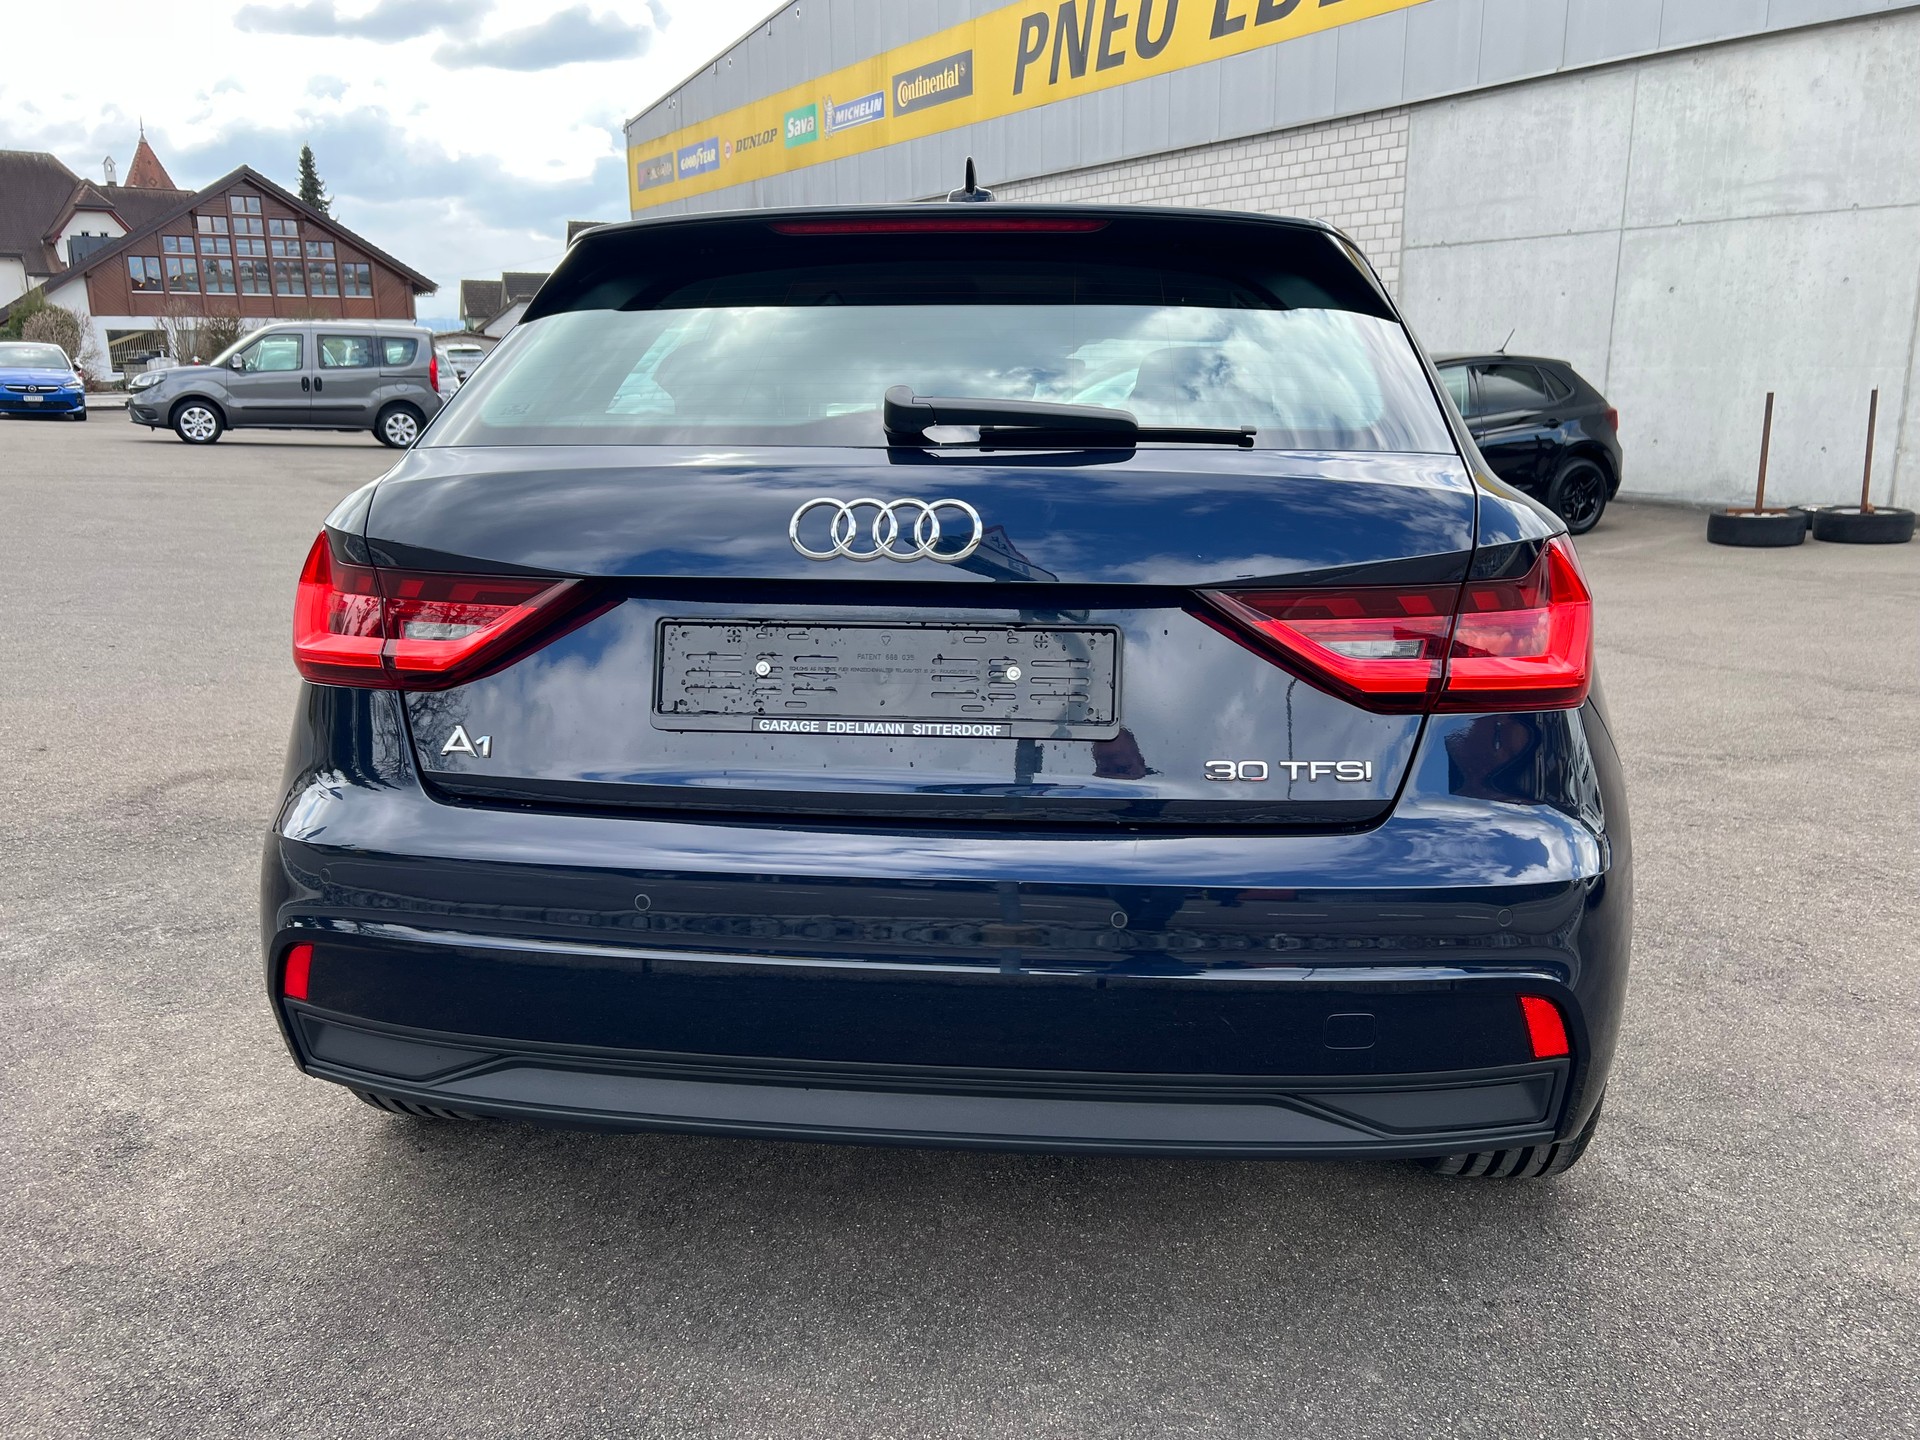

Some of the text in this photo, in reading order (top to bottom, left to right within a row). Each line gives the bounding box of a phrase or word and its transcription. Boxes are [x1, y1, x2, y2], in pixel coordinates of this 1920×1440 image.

[1013, 0, 1177, 95] PNEU
[897, 63, 959, 107] Continental
[836, 97, 883, 124] MICHELIN
[787, 115, 815, 139] Sava
[735, 128, 778, 153] DUNLOP
[856, 653, 881, 661] PATENT
[759, 719, 1002, 737] GARAGE EDELMANN SITTERDORF
[440, 725, 492, 758] A1
[1204, 760, 1373, 783] 30 TFSI
